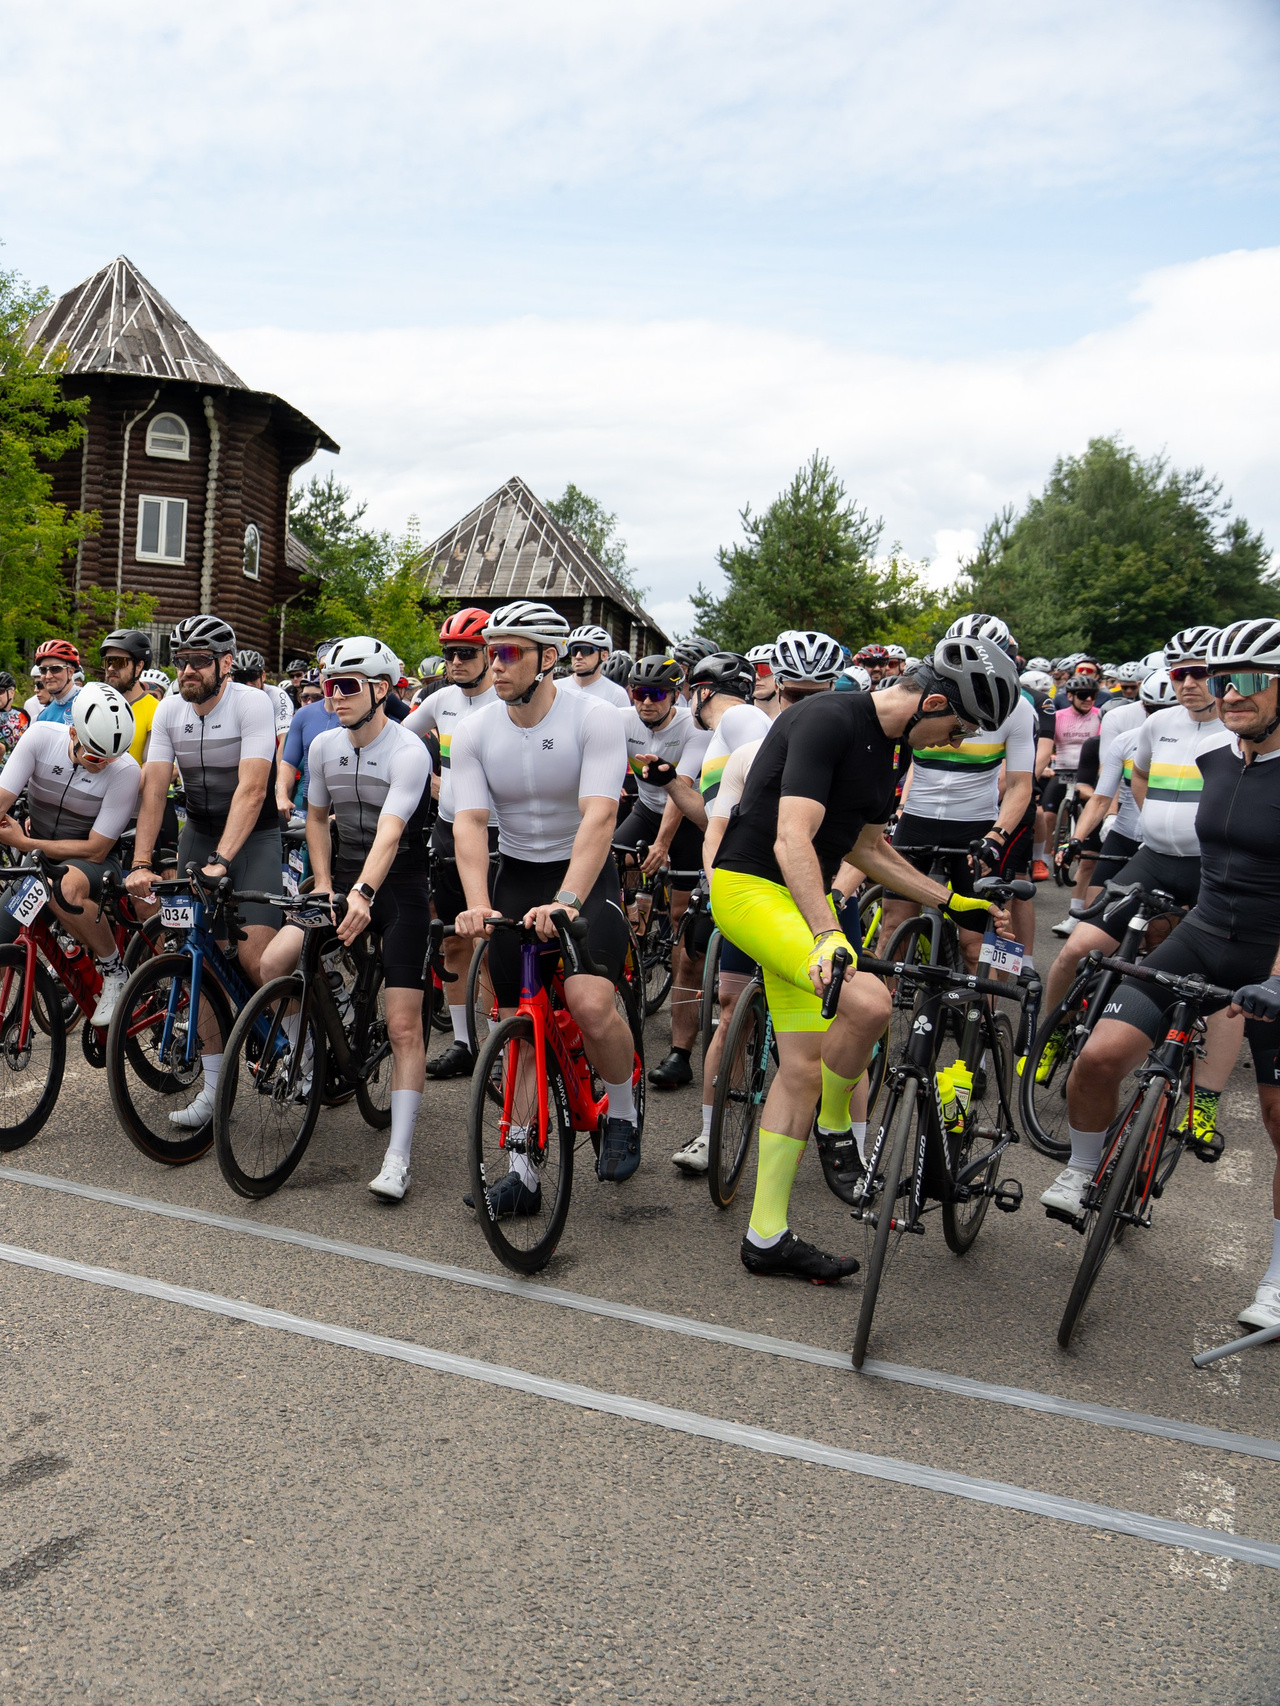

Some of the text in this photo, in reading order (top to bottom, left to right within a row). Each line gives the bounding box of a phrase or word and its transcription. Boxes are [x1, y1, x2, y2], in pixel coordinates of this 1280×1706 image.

[975, 645, 996, 675] KASK
[18, 886, 44, 918] 4036
[162, 908, 189, 921] 034
[1166, 1029, 1189, 1044] BH
[556, 1073, 570, 1127] DT SWISS
[479, 1163, 496, 1222] DT SWISS
